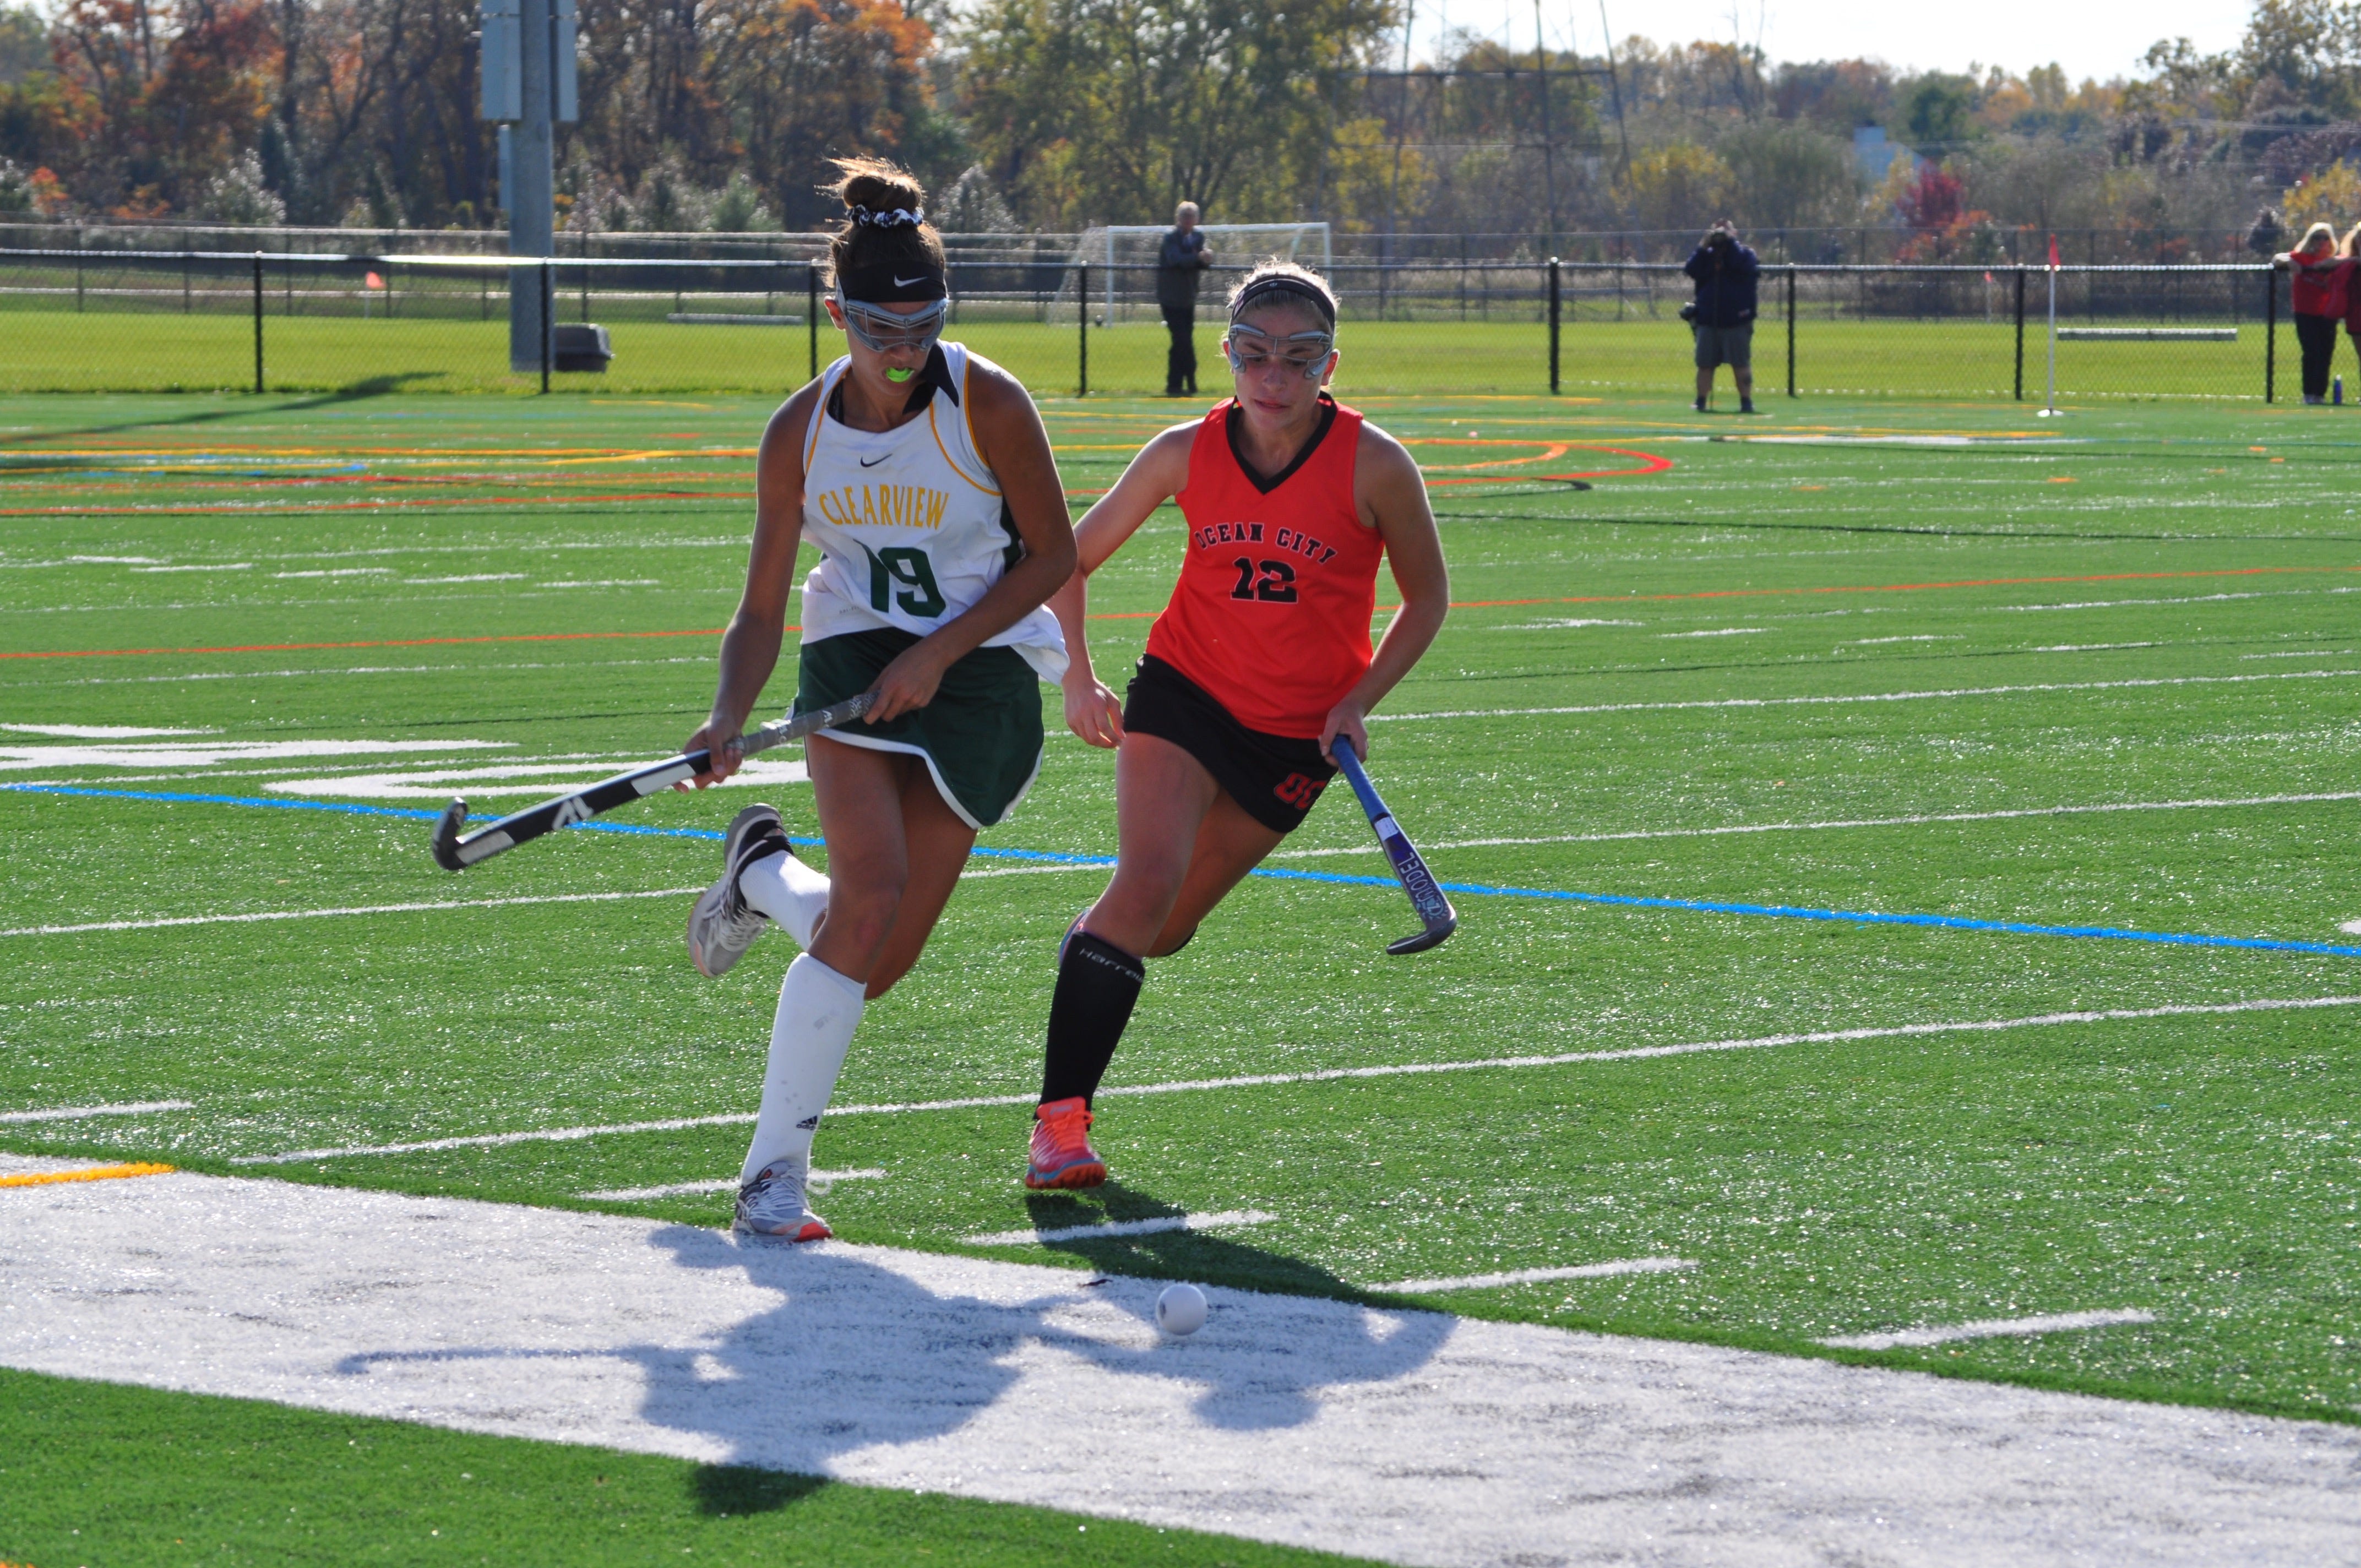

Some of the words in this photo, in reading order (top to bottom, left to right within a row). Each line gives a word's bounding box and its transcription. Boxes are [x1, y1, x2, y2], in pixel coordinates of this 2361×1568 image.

[819, 484, 949, 530] CLEARVIEW
[1194, 522, 1264, 549] OCEAN
[1276, 527, 1337, 564] CITY
[853, 538, 946, 618] 19
[1231, 557, 1298, 603] 12
